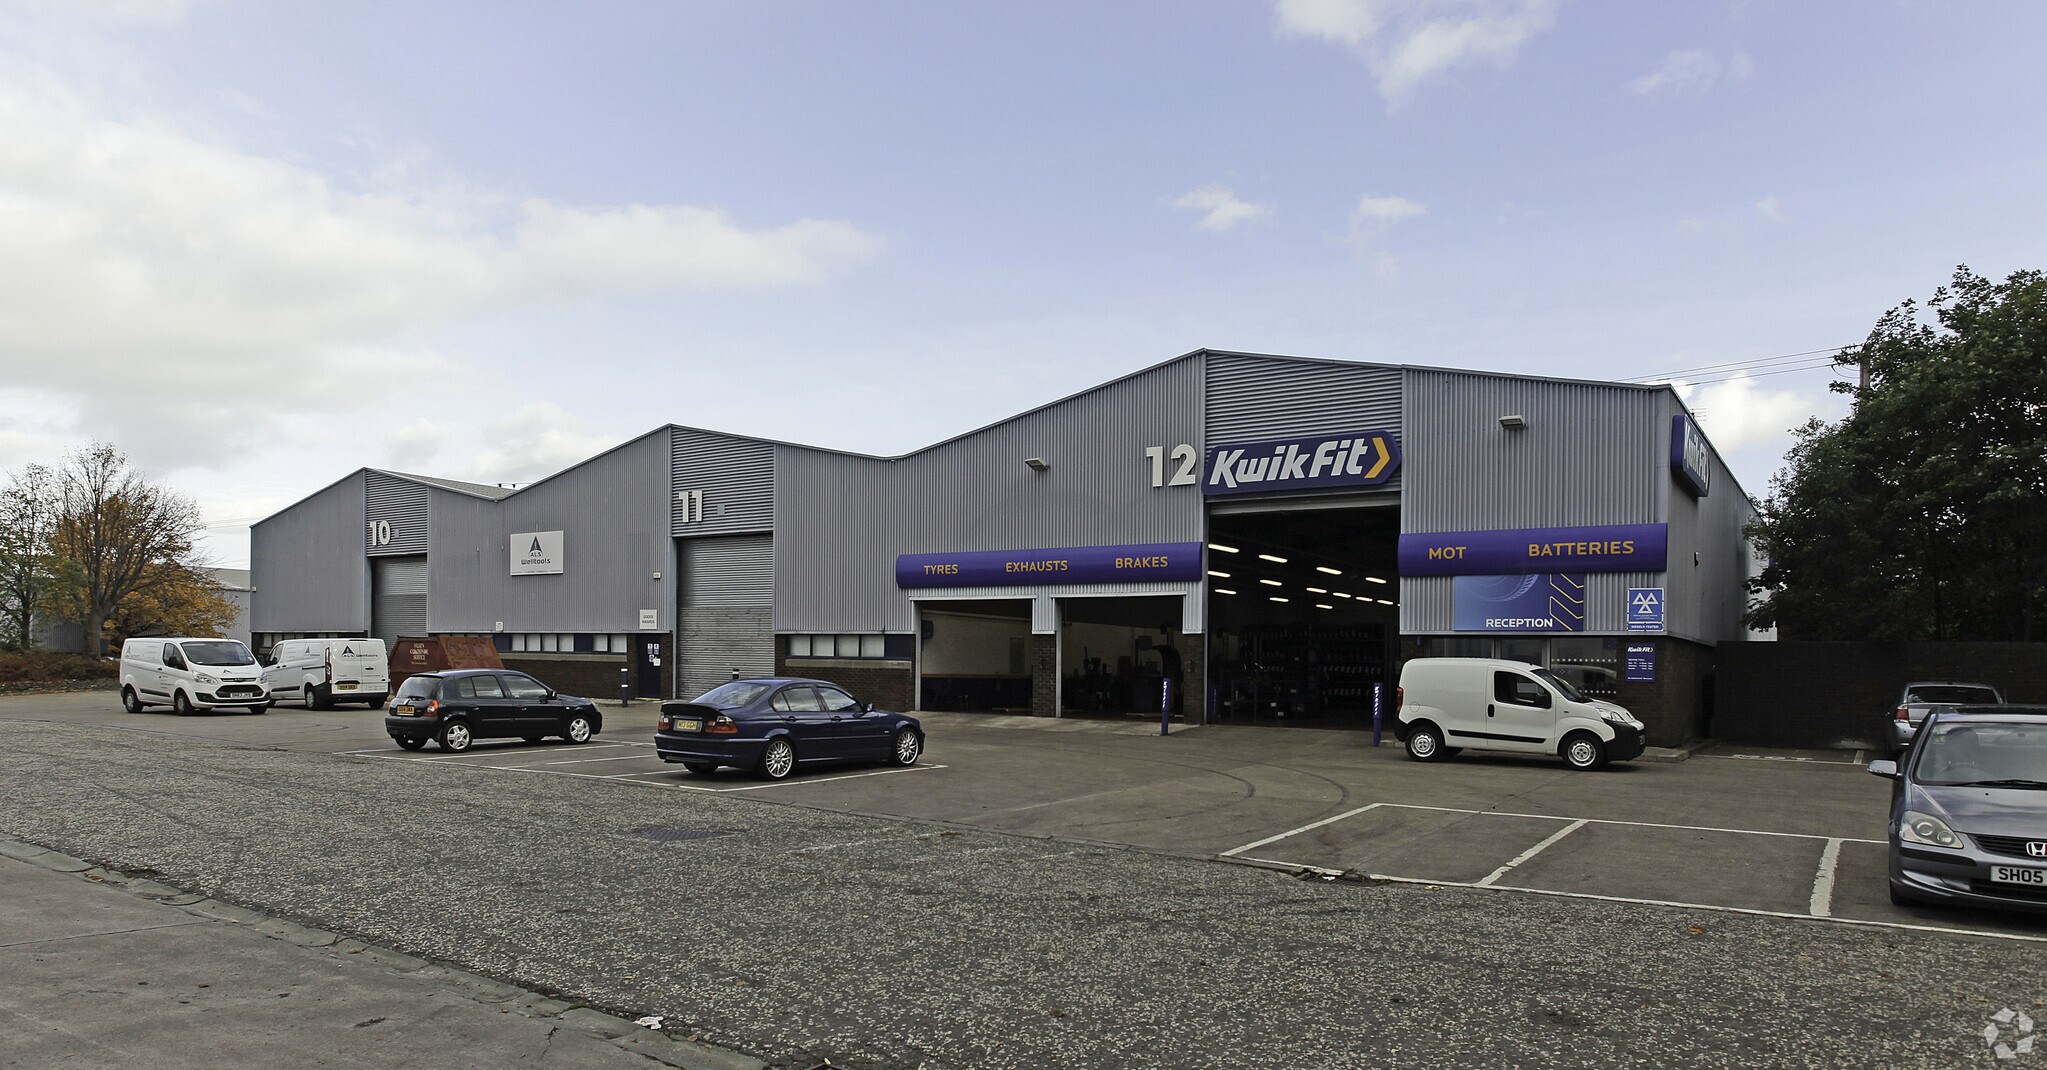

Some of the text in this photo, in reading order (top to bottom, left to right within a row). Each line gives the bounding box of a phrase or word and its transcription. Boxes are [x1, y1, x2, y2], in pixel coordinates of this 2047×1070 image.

[1146, 444, 1197, 488] 12
[679, 490, 704, 523] 11
[369, 520, 391, 546] 10
[1428, 540, 1635, 560] MOT BATTERIES
[923, 555, 1169, 576] TYRES EXHAUSTS BRAKES
[1485, 617, 1554, 629] RECEPTION
[1998, 867, 2044, 884] SH05
